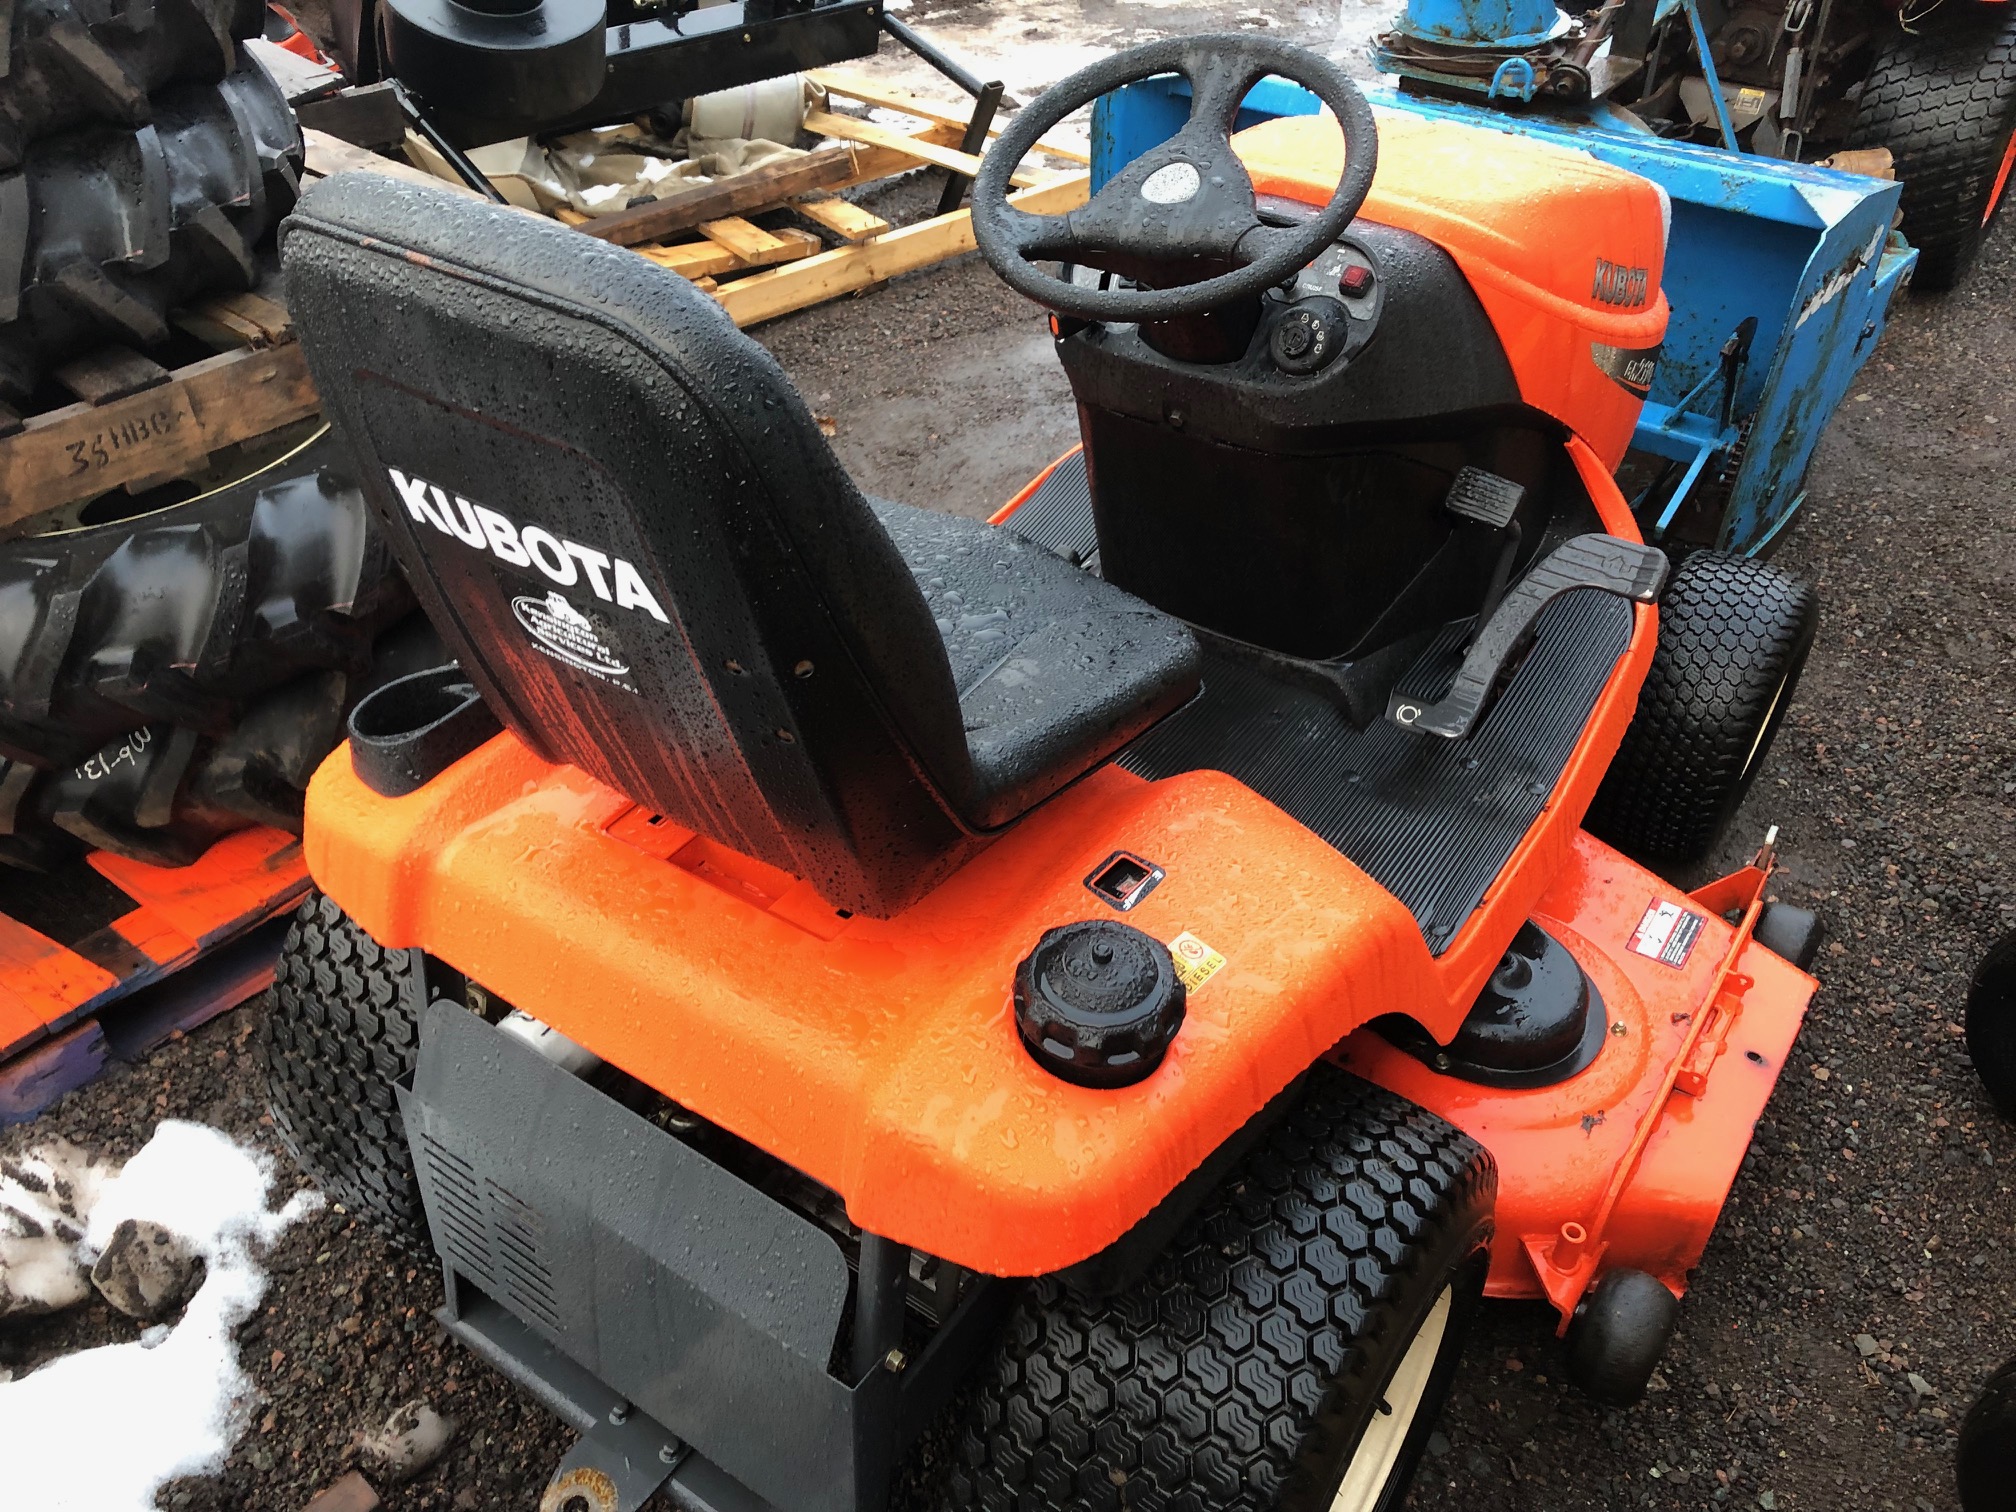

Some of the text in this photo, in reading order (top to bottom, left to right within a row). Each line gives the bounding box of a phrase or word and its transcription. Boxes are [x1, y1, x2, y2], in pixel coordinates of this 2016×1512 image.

[1592, 257, 1648, 307] KUBOTA
[389, 468, 670, 624] KUBOTA
[521, 602, 598, 643] Kensington
[531, 615, 610, 656] Agricultural
[536, 626, 593, 657] Services
